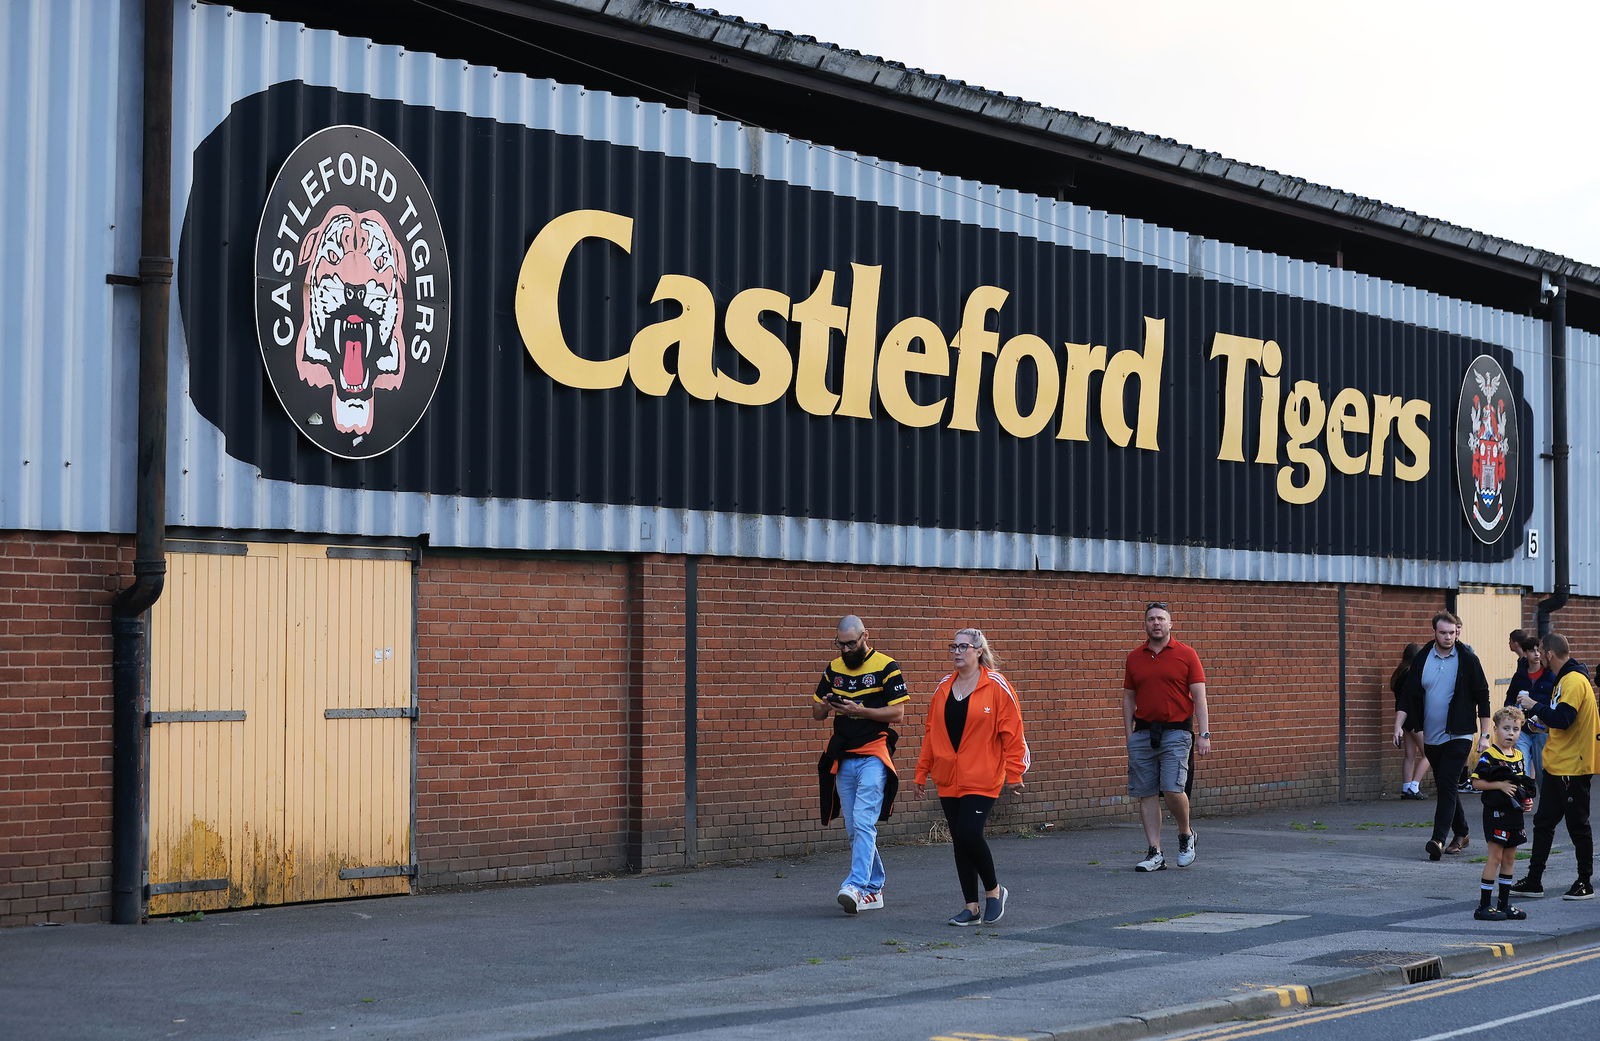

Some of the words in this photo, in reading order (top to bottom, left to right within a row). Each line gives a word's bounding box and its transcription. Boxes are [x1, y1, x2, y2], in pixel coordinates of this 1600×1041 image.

[271, 152, 398, 347] CASTLEFORD
[398, 195, 435, 364] TIGERS
[514, 209, 1166, 452] Castleford
[1209, 331, 1432, 505] Tigers
[1530, 532, 1537, 555] 5
